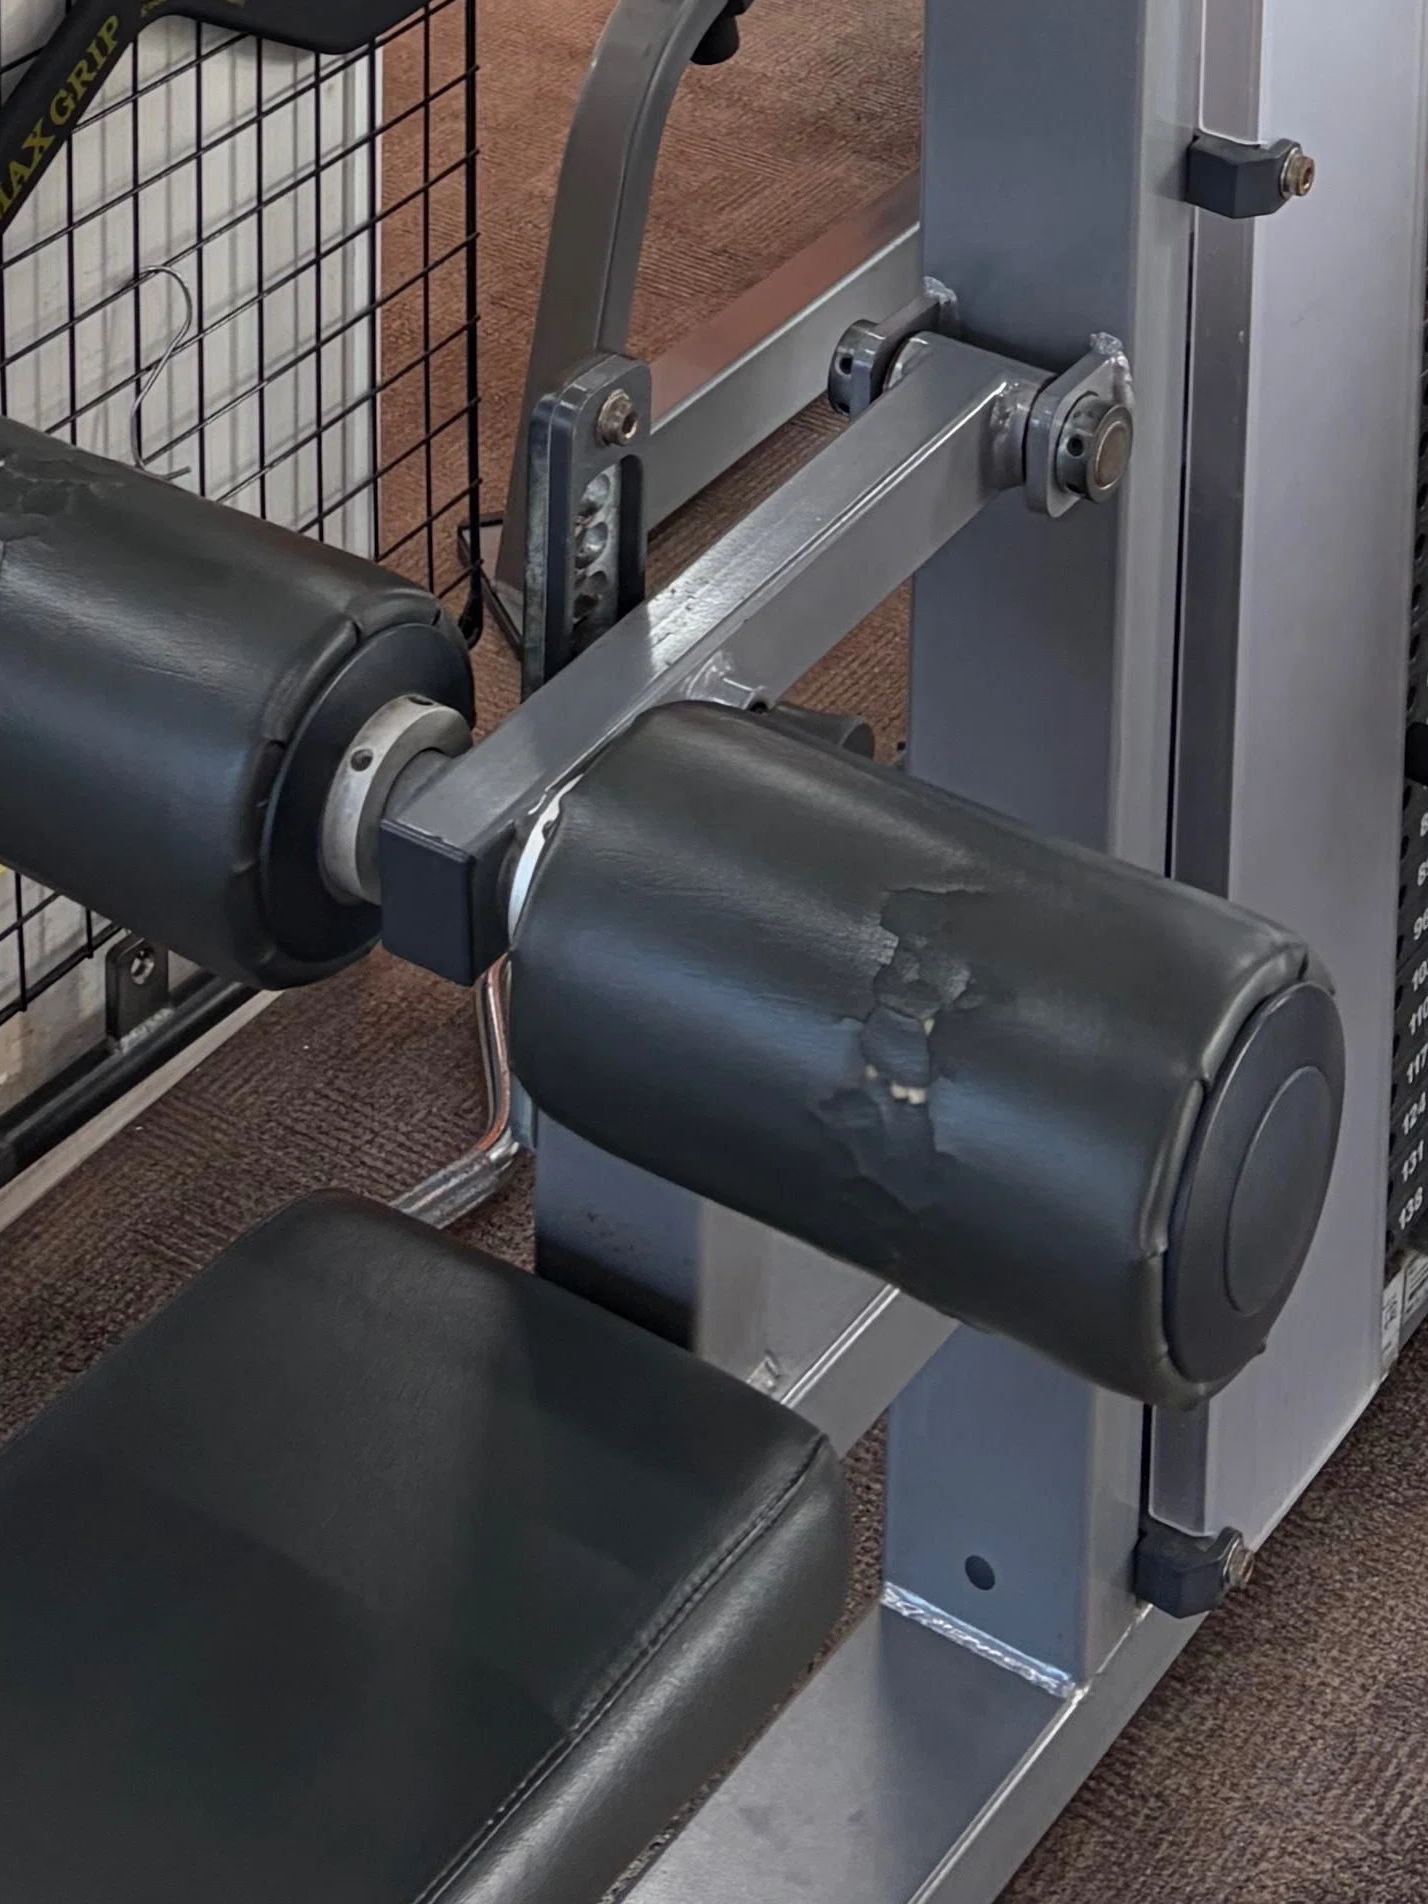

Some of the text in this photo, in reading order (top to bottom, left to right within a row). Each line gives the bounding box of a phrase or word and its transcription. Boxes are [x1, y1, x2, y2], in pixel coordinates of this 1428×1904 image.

[49, 14, 120, 128] GRIP
[1406, 1042, 1428, 1084] 117
[1402, 1091, 1427, 1135] 124
[1401, 1140, 1424, 1183] 131
[1398, 1186, 1424, 1230] 138
